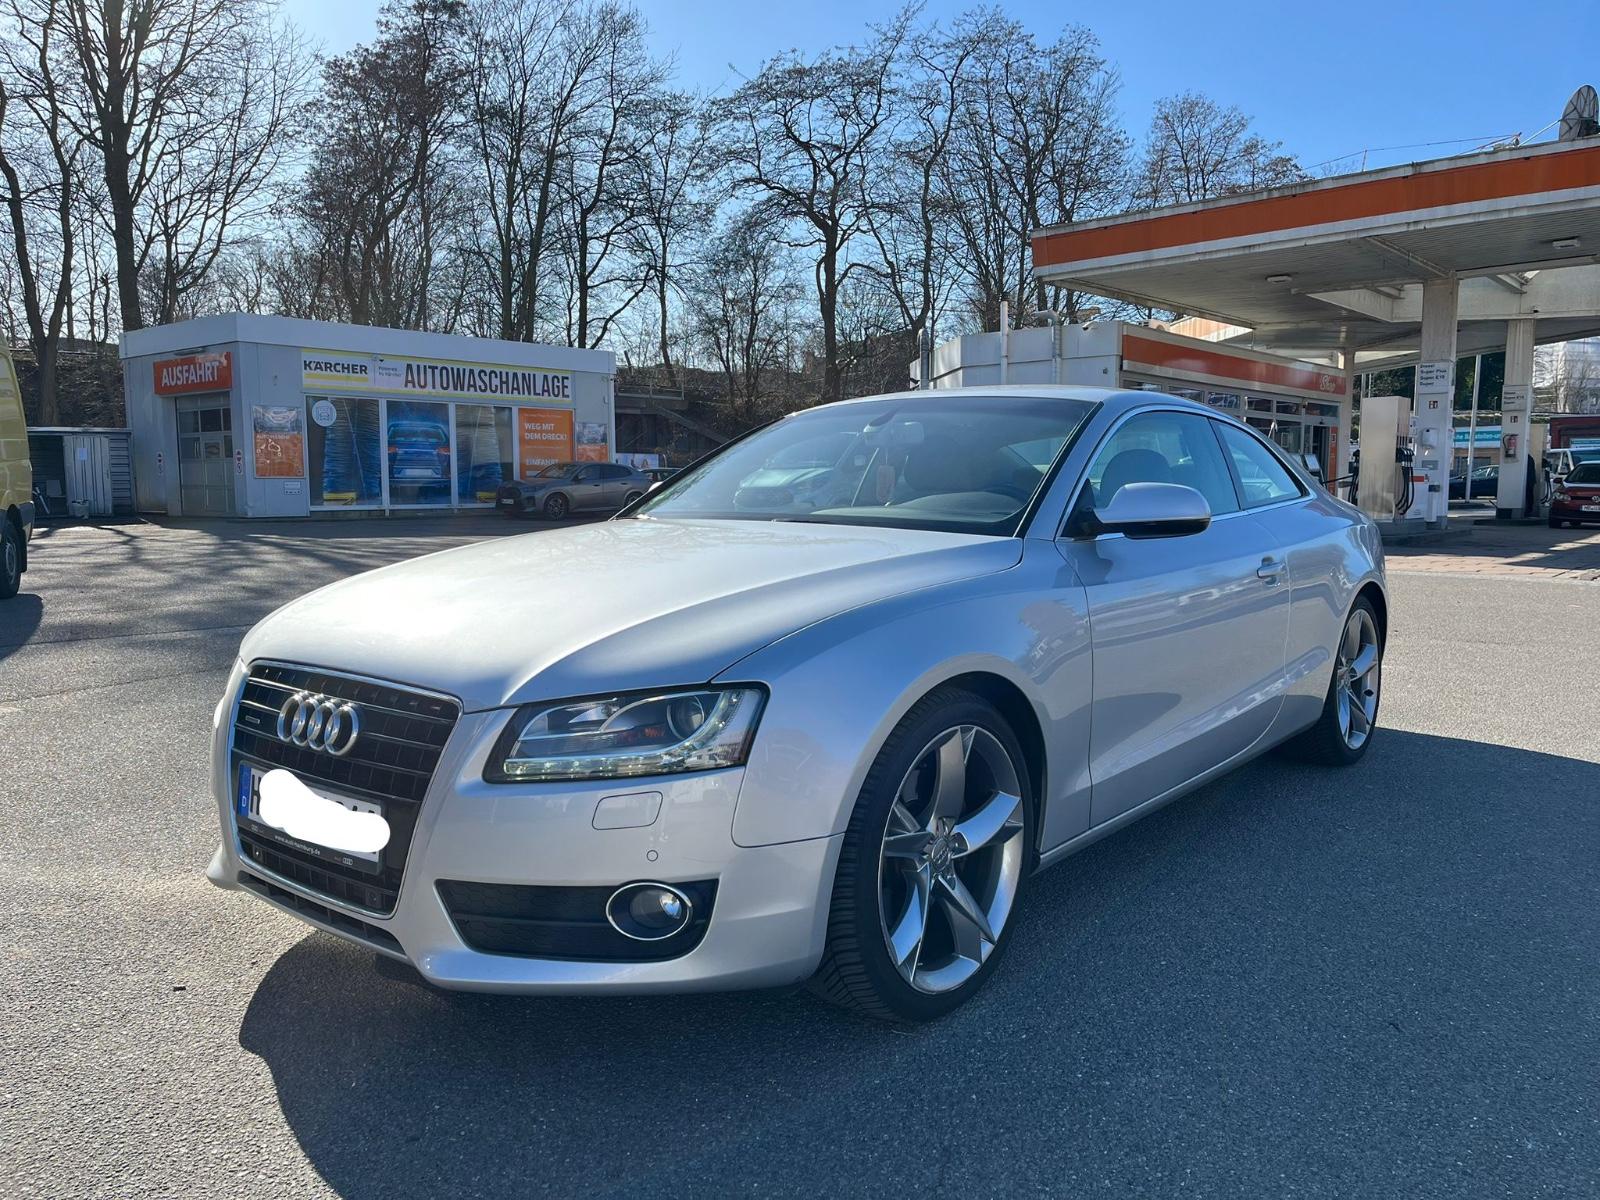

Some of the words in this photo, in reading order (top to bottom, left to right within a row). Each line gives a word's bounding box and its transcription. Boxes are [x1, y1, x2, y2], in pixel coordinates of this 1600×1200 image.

[162, 361, 219, 387] AUSFAHRT
[303, 360, 368, 375] KÄRCHER
[404, 363, 571, 398] AUTOWASCHANLAGE
[543, 423, 555, 431] MIT
[525, 432, 542, 440] DEM
